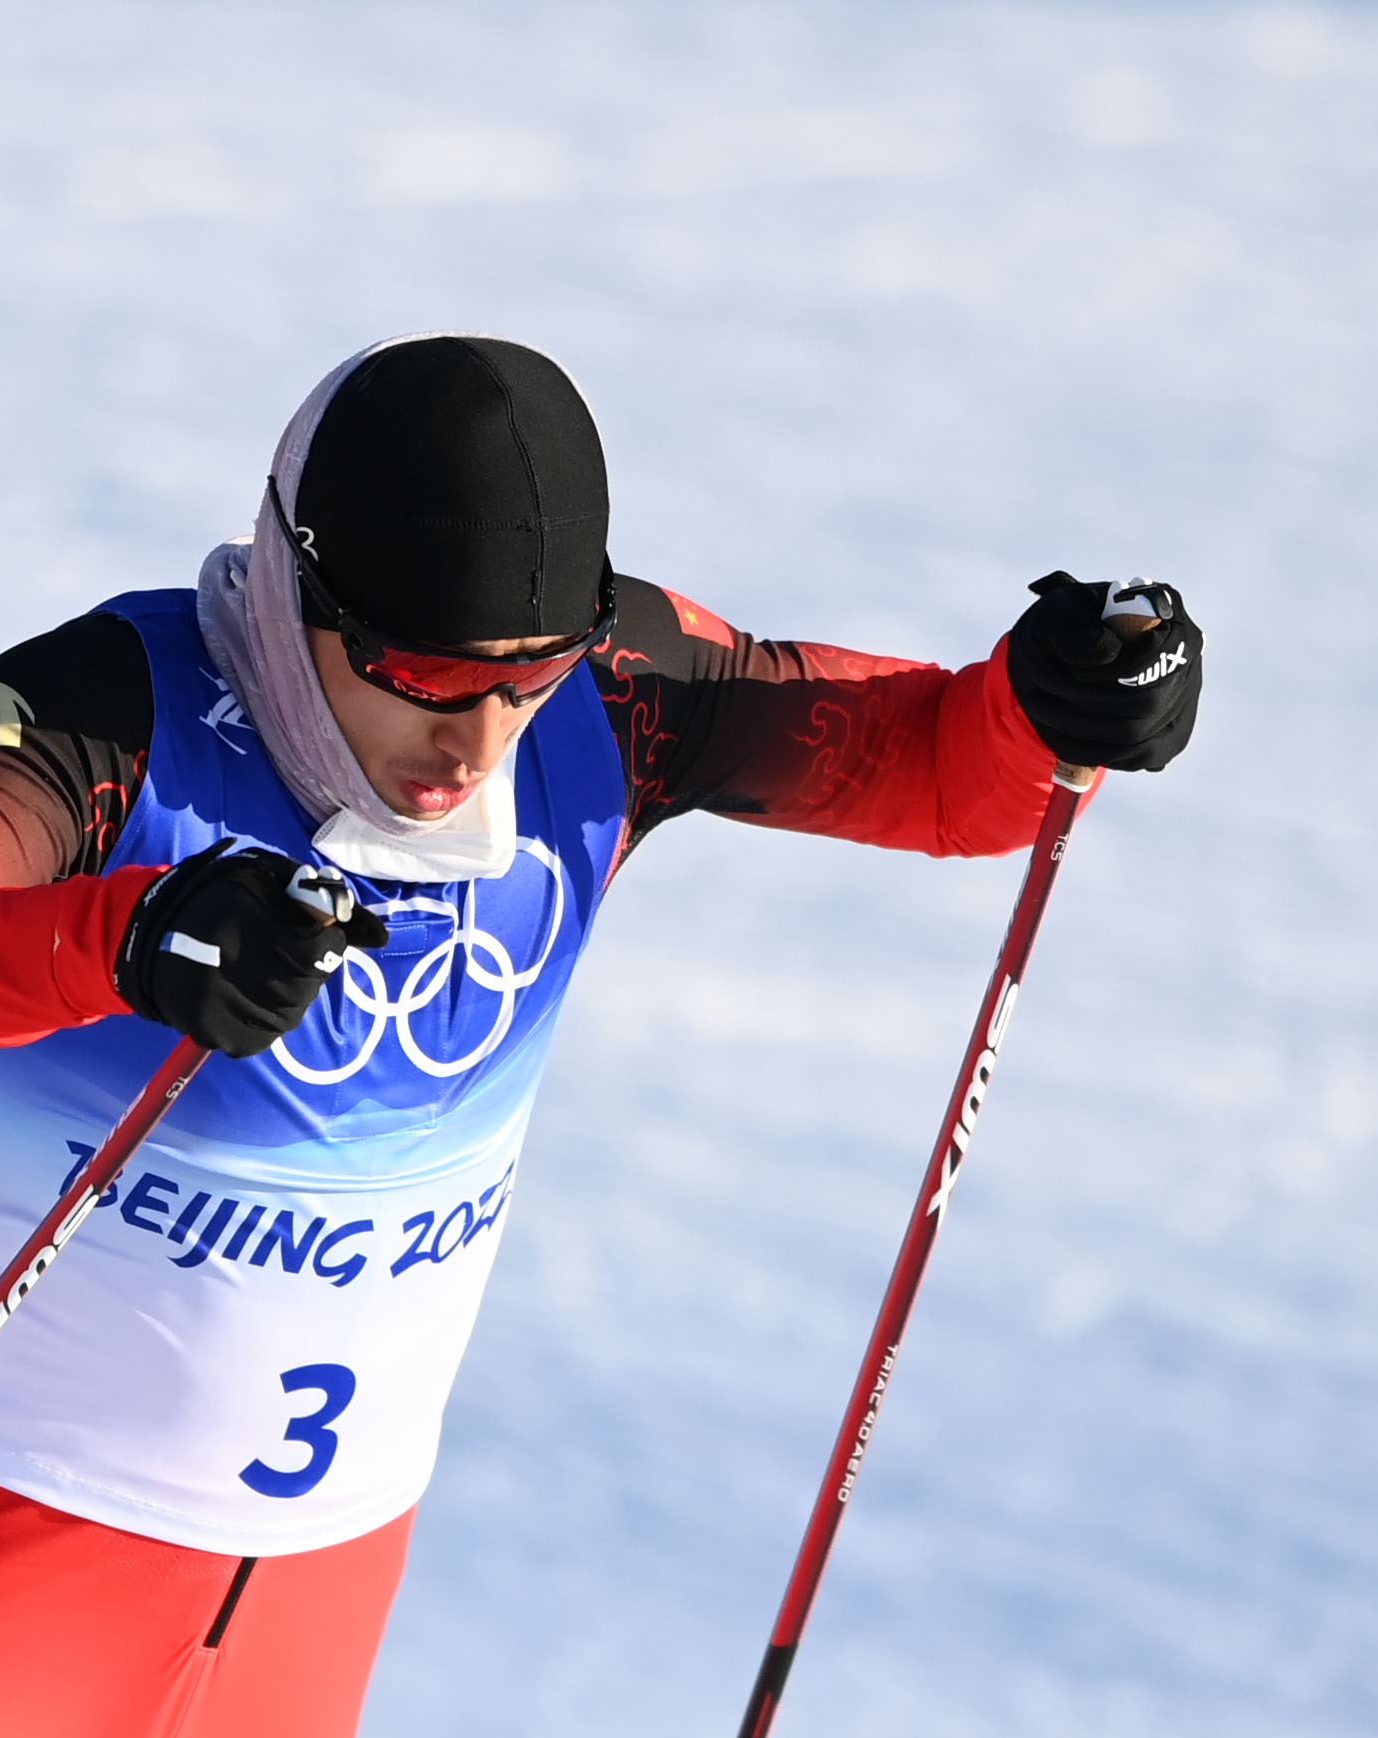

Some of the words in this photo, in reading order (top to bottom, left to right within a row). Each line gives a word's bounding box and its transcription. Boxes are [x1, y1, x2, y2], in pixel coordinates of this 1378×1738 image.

[1050, 833, 1069, 861] TCS
[165, 1075, 191, 1100] TCS
[869, 1344, 899, 1405] TRIAC
[238, 1363, 357, 1499] 3
[837, 1442, 864, 1503] AERO
